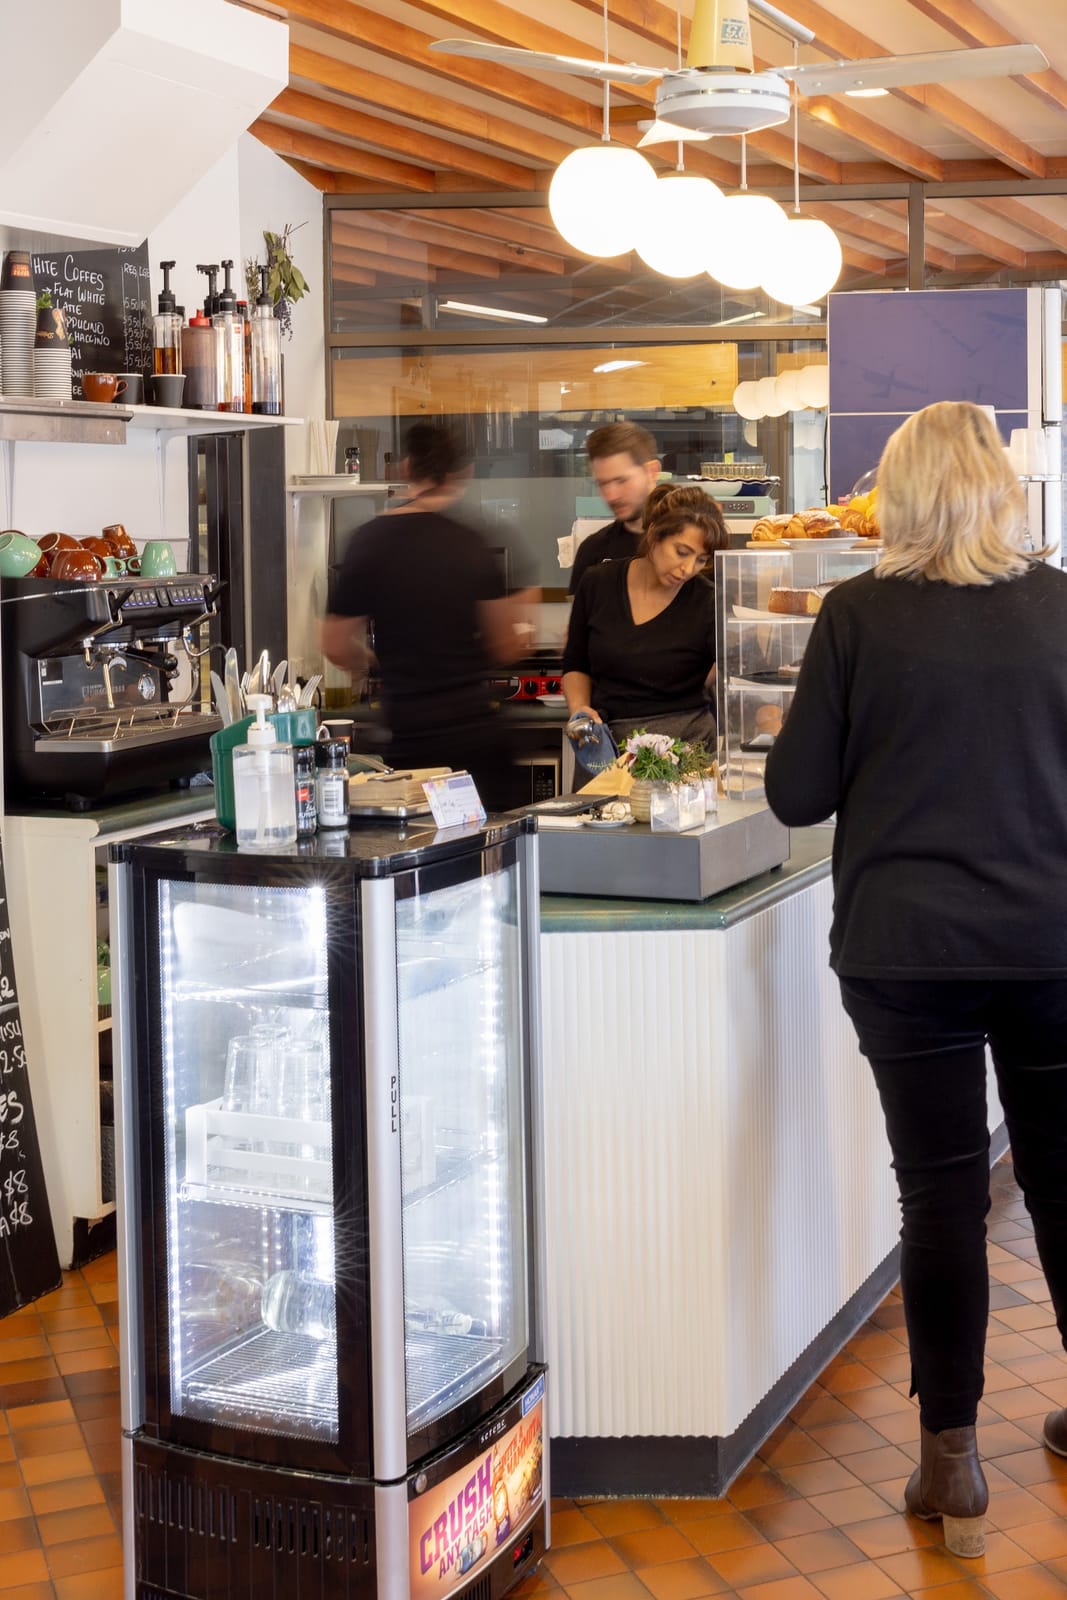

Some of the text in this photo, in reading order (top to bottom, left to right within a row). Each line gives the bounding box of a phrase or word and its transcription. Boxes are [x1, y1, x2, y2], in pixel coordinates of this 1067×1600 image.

[33, 256, 58, 277] HITE
[64, 254, 104, 291] COFFES
[54, 282, 105, 306] FLAT WHITE
[0, 1020, 22, 1042] ISU
[0, 1090, 24, 1125] ES
[4, 1169, 28, 1206] $8
[10, 1200, 33, 1232] $8
[420, 1453, 492, 1576] CRUSH
[438, 1538, 462, 1581] ANY
